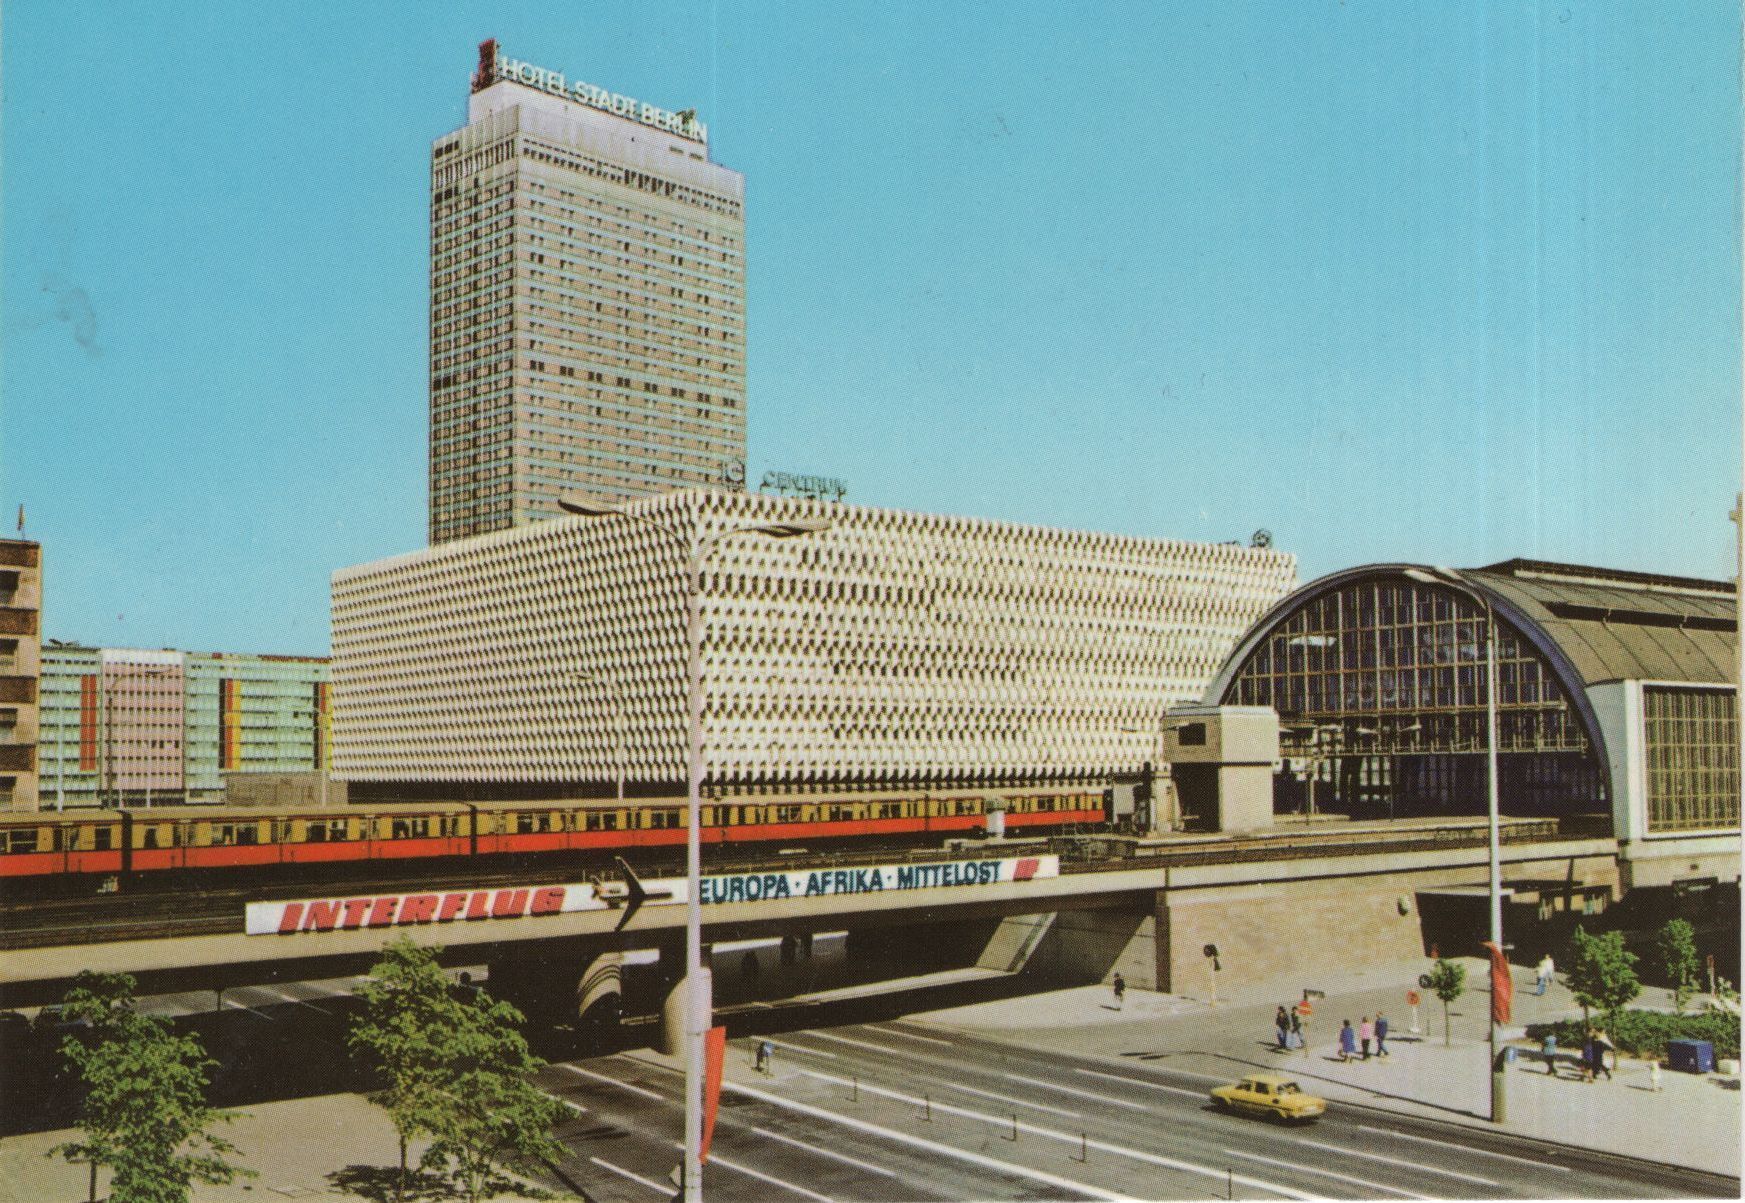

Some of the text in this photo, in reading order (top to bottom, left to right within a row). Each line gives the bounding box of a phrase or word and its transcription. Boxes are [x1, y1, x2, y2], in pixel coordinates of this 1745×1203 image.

[501, 55, 571, 98] HOTEL
[575, 80, 638, 116] STADT
[699, 861, 1002, 905] EUROPA AFRIKA MITTELOST
[278, 885, 567, 935] INTERFLUG
